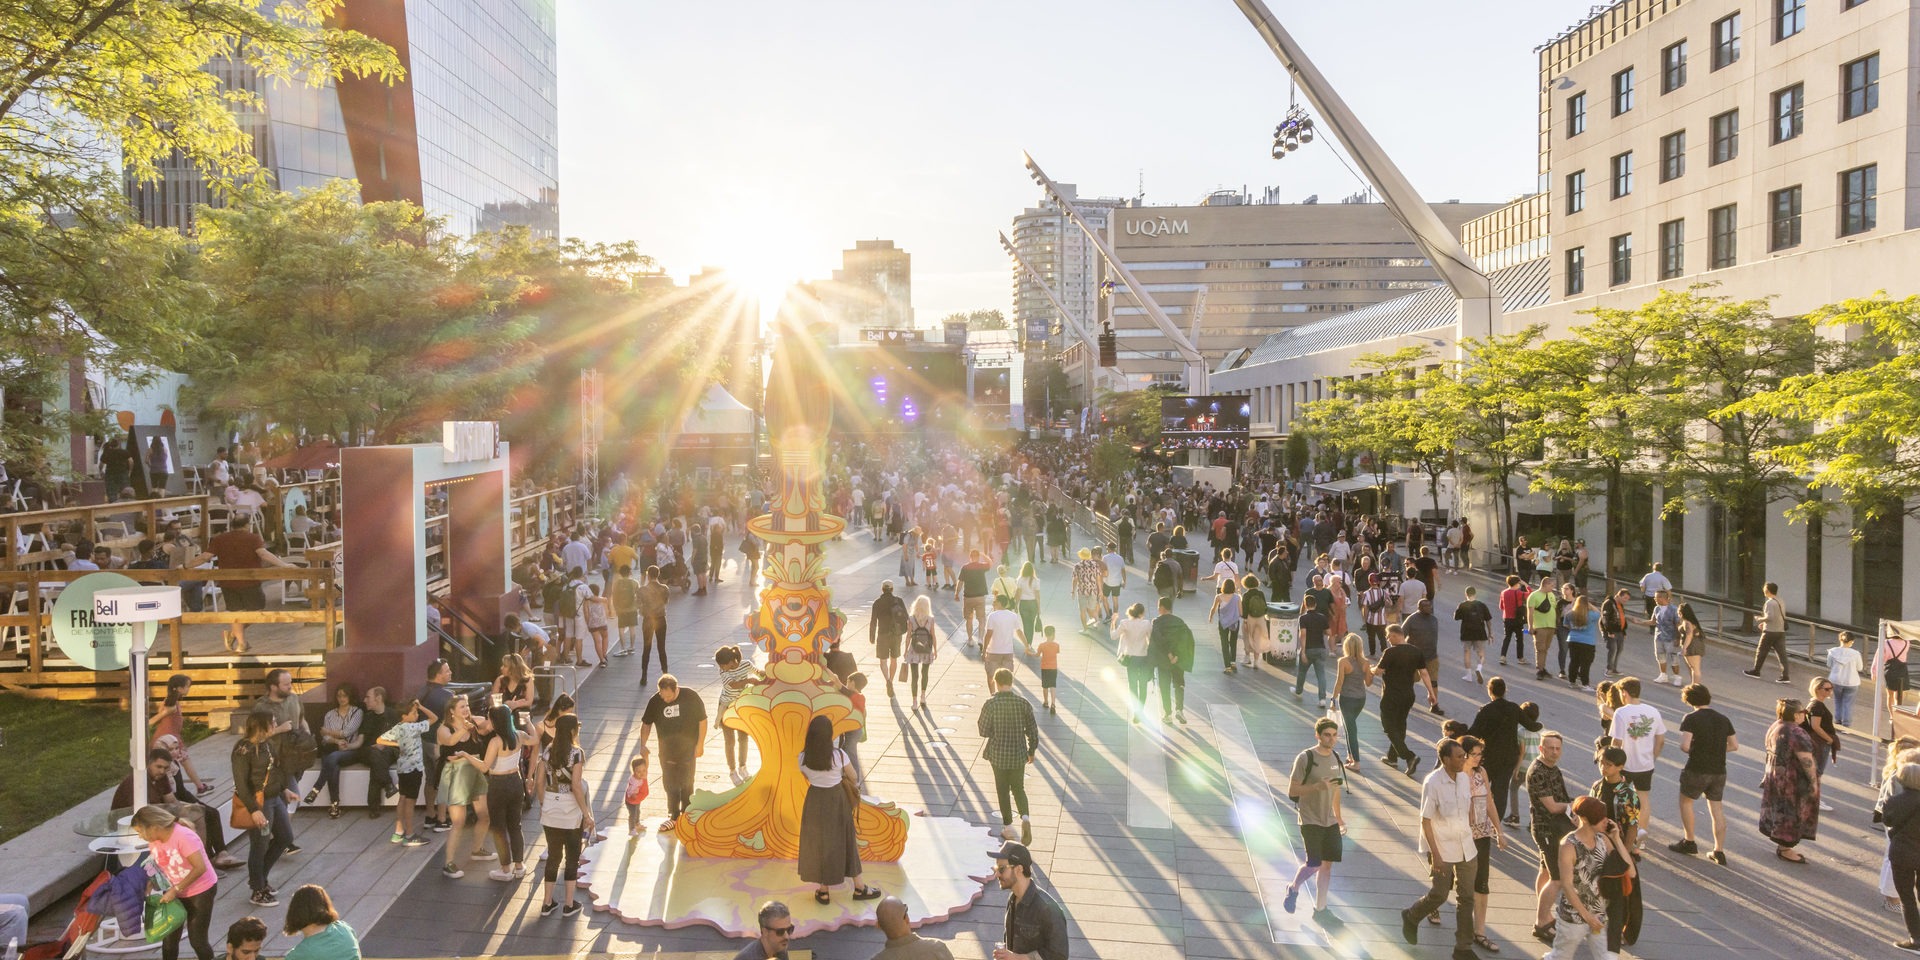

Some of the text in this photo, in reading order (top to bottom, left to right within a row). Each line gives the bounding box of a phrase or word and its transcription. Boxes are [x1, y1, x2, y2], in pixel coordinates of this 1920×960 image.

[1126, 216, 1189, 238] UQÀM
[867, 330, 884, 341] Bell
[926, 559, 934, 567] 31
[96, 600, 118, 615] Bell
